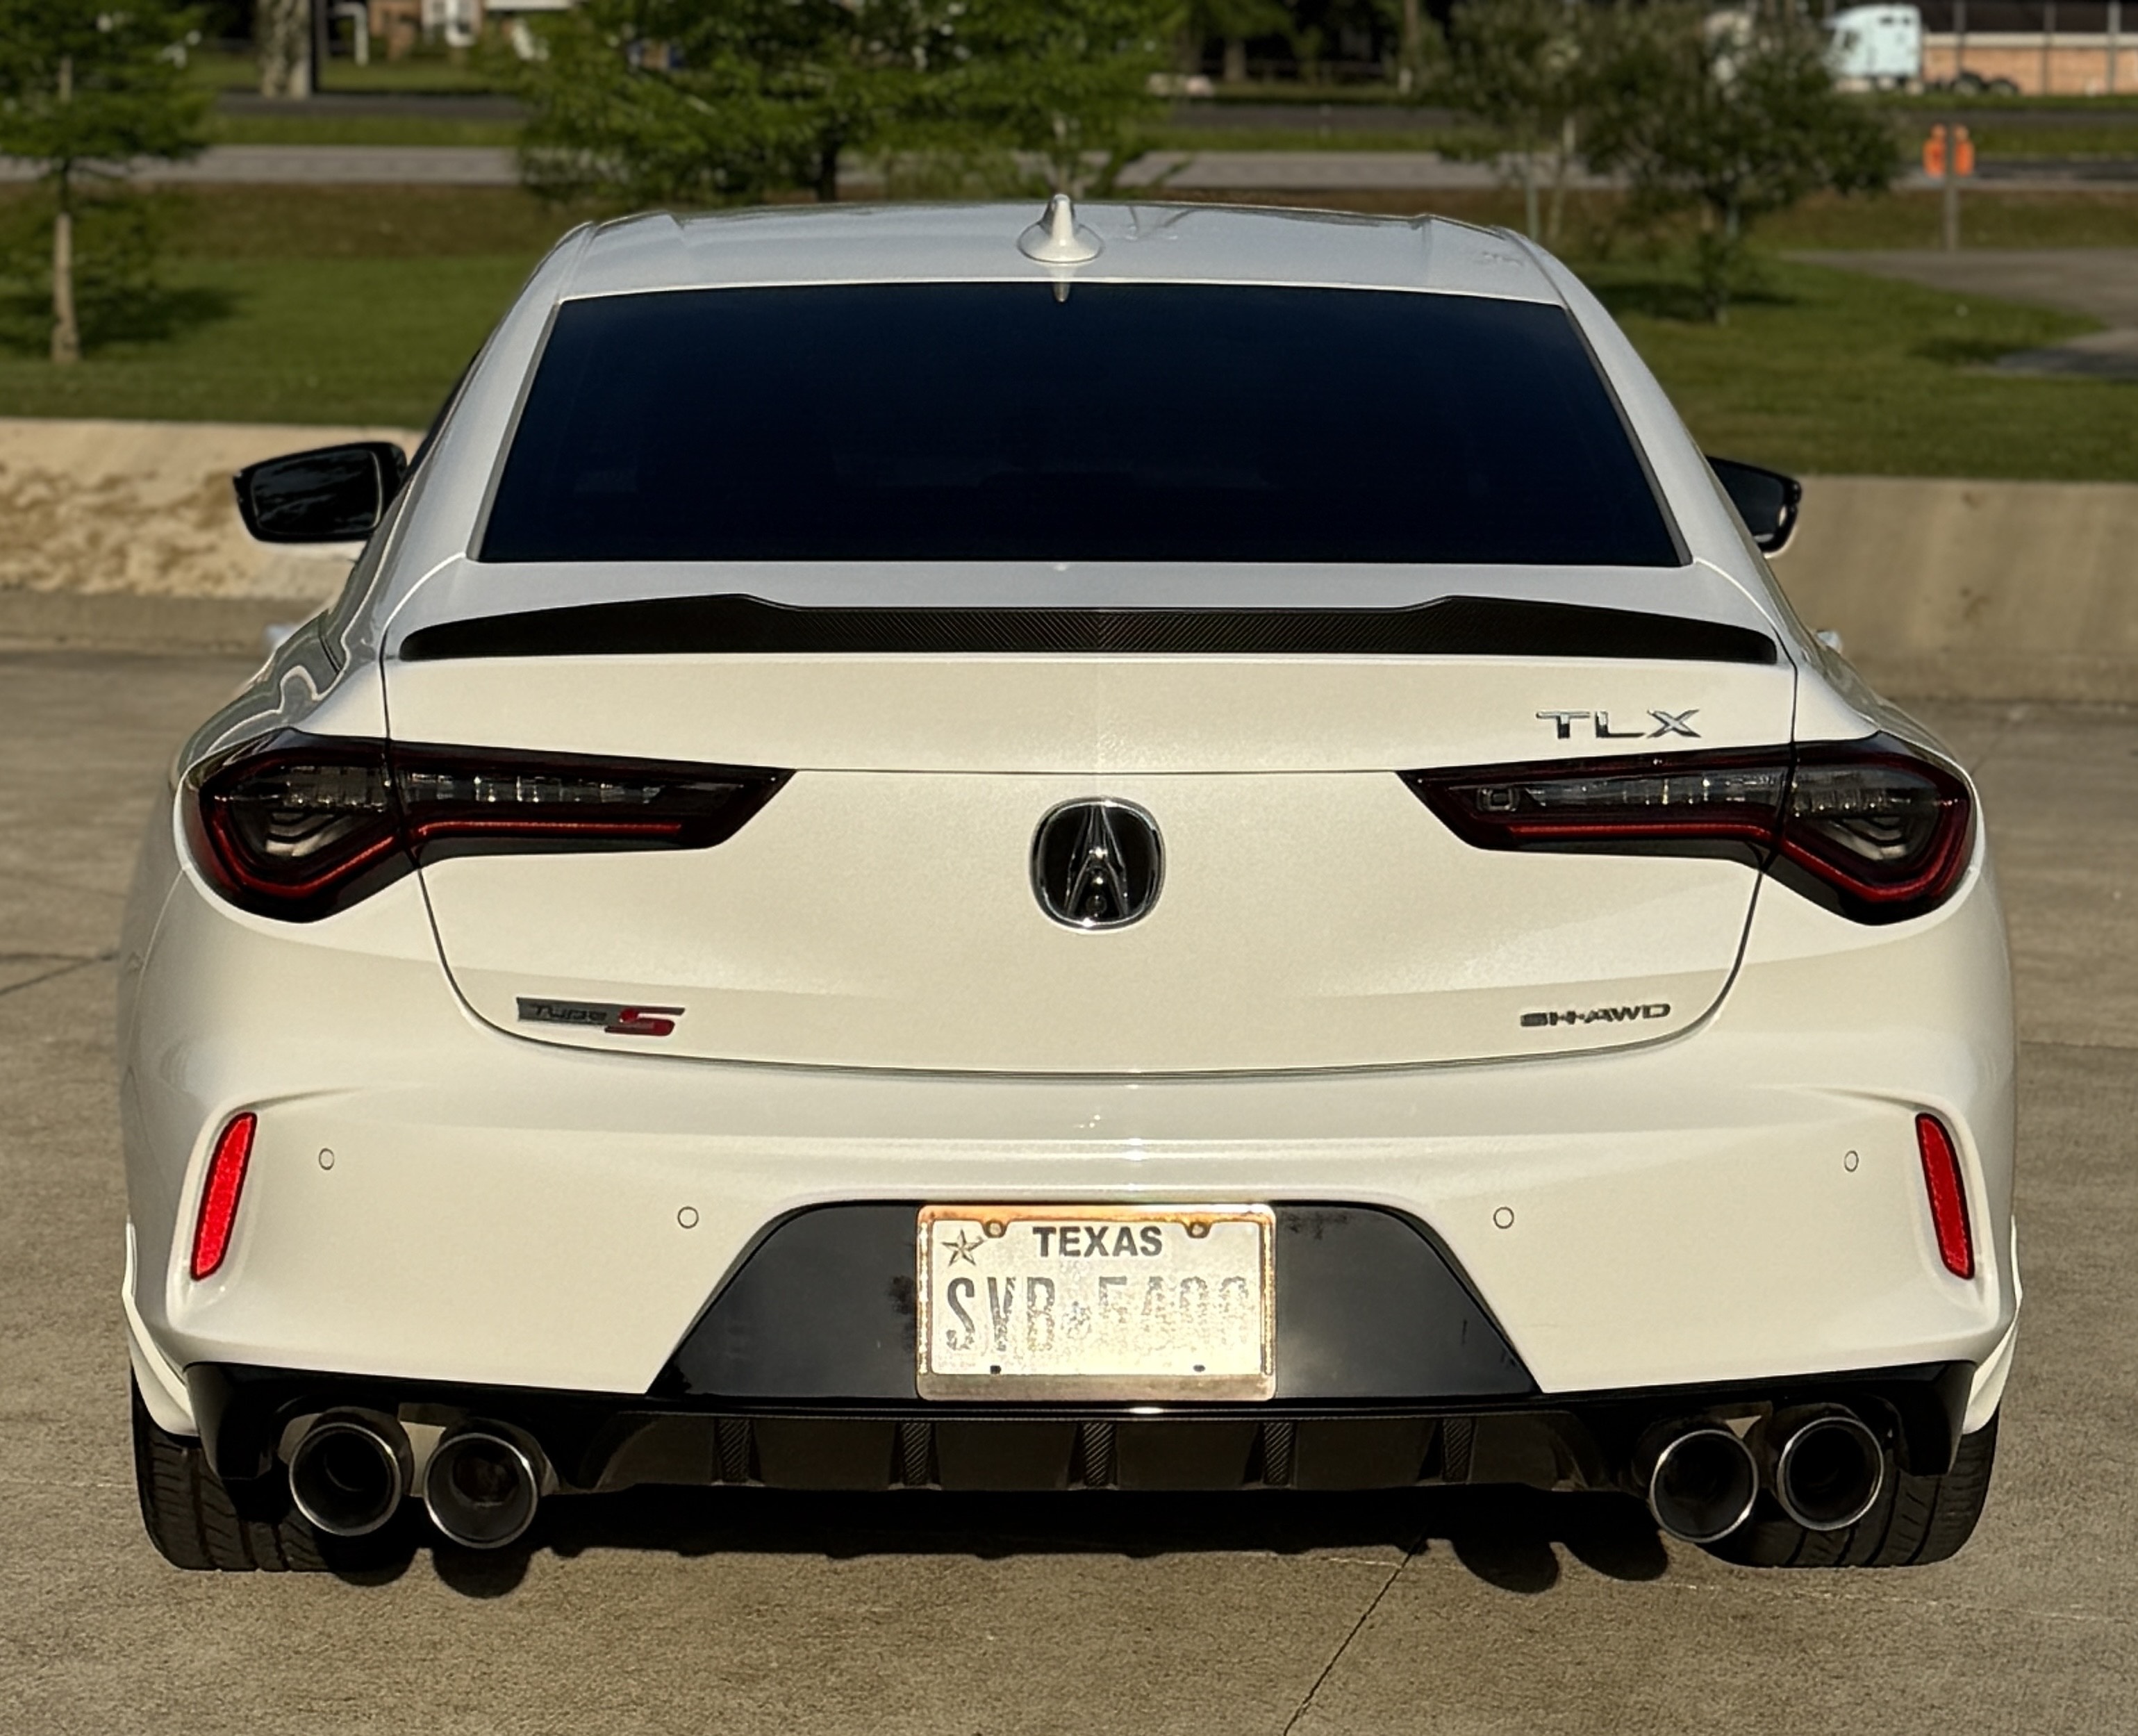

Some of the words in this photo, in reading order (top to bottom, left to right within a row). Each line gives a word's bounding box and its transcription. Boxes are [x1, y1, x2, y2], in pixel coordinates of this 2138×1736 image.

[1536, 709, 1701, 739] TLX
[604, 1005, 685, 1036] S
[1033, 1226, 1163, 1257] TEXAS
